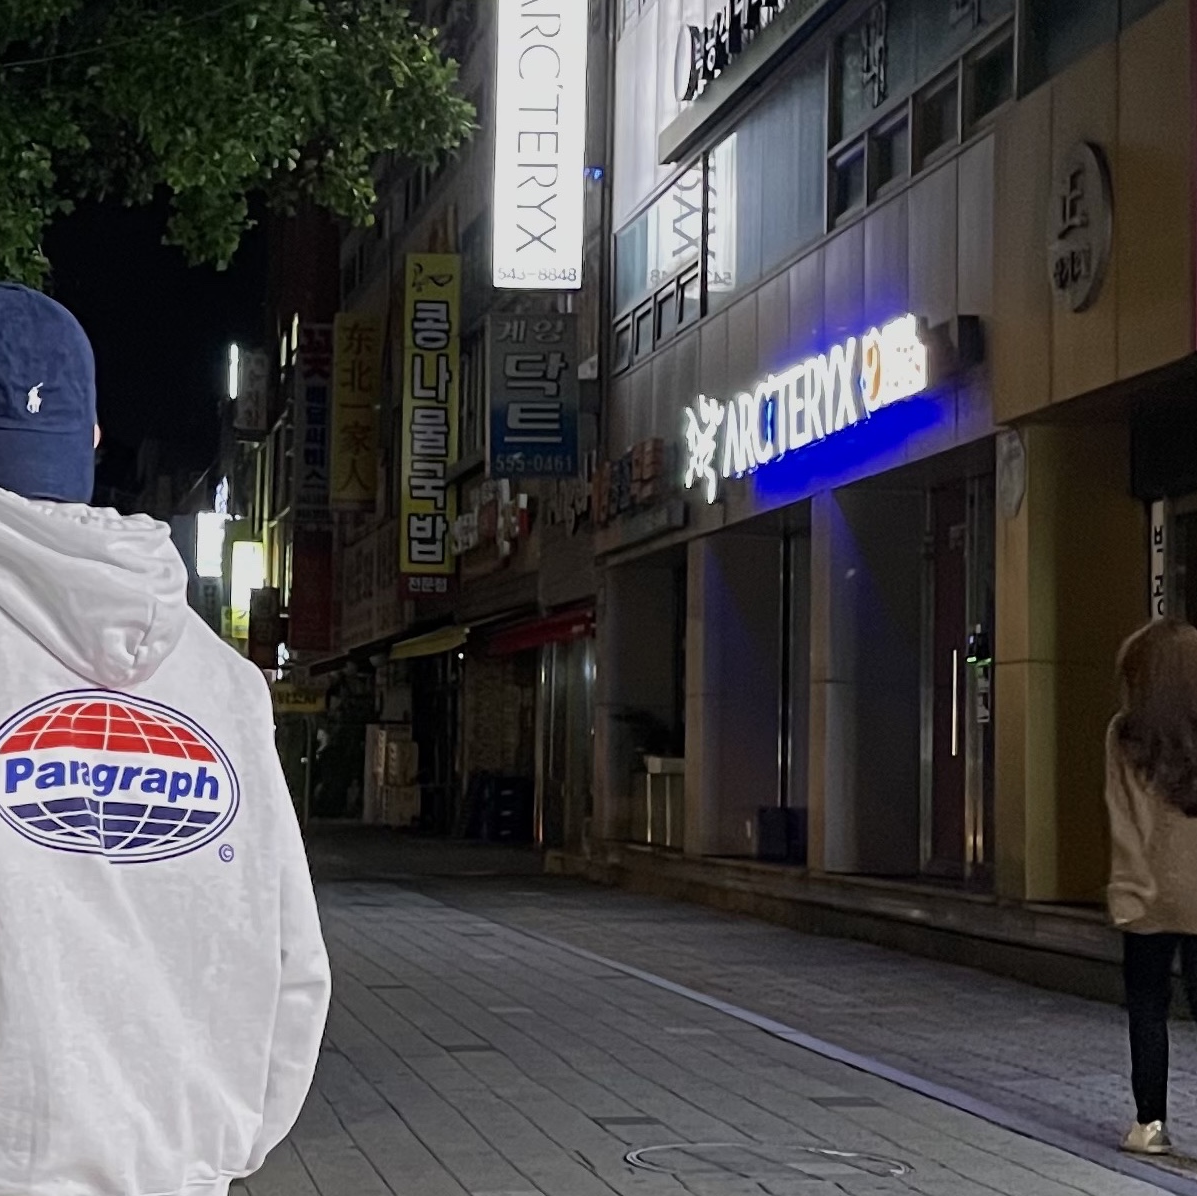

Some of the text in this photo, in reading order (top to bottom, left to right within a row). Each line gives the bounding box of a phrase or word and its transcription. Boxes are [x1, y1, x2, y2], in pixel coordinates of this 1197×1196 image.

[515, 0, 564, 253] RC'TERYX
[497, 267, 577, 283] 543-8848
[338, 322, 375, 491] 东北一家人
[407, 300, 452, 565] 콩나물국밥
[504, 352, 569, 444] 닥트
[4, 757, 220, 803] Paragraph
